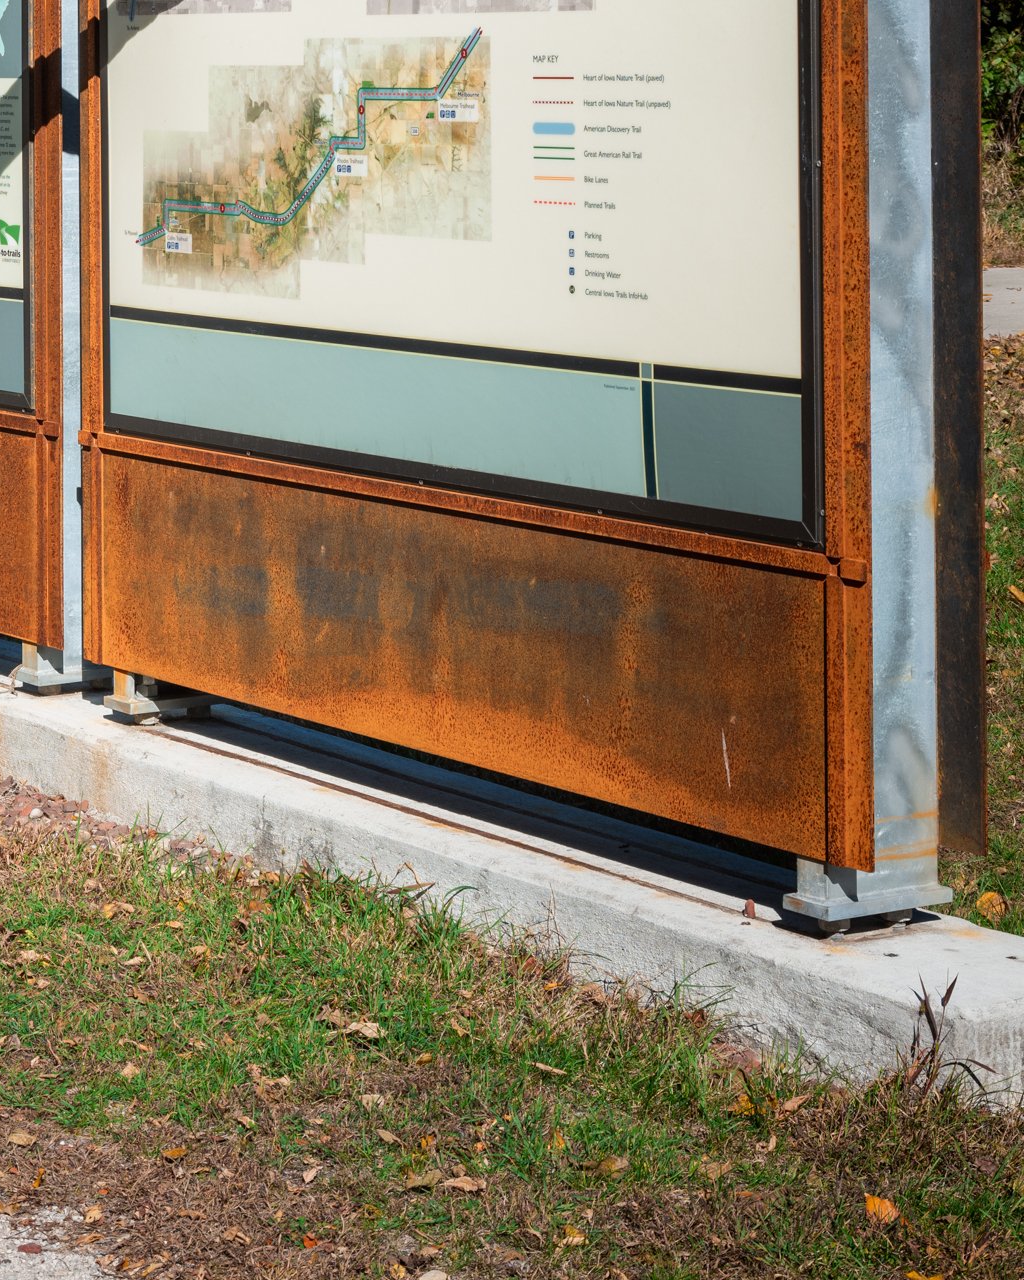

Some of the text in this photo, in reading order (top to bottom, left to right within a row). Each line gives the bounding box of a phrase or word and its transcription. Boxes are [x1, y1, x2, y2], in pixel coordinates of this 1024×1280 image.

[532, 55, 559, 63] MAP KEY
[583, 73, 597, 81] Heart
[598, 73, 603, 81] of
[646, 74, 664, 83] (paved)
[583, 99, 597, 107] Heart
[646, 100, 671, 109] (unpaved)
[607, 125, 630, 134] Discovery
[632, 125, 642, 133] Trail
[632, 151, 642, 159] Trail
[584, 175, 594, 183] Bike
[584, 201, 616, 210] Planned Trails
[584, 231, 602, 241] Parking
[584, 250, 610, 259] Restrooms
[584, 269, 621, 279] Drinking Water
[585, 288, 602, 296] Central
[615, 290, 627, 298] Trails
[629, 291, 648, 300] InfoHub
